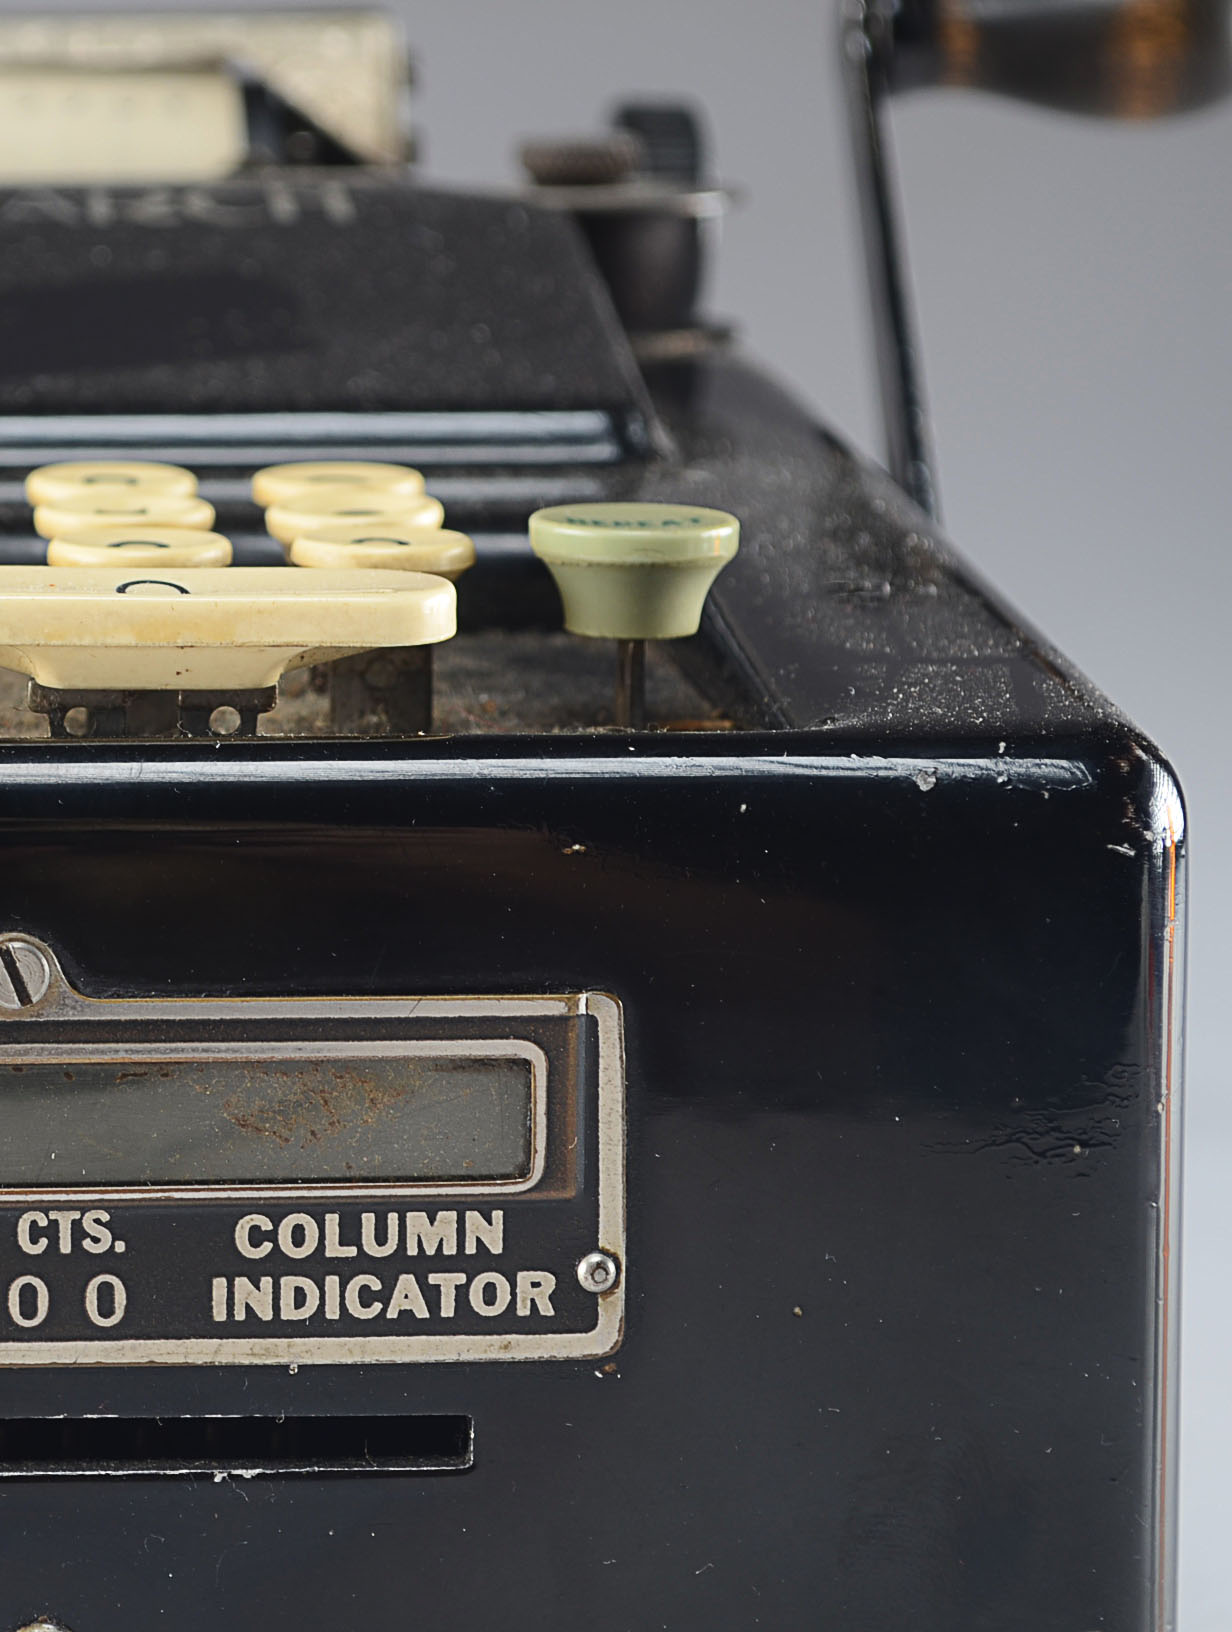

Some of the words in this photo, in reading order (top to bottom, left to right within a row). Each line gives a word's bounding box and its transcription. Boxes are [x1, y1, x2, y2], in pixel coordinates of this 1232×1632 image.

[17, 1210, 126, 1254] CTS.
[235, 1210, 503, 1259] COLUMN
[212, 1271, 556, 1321] INDICATOR
